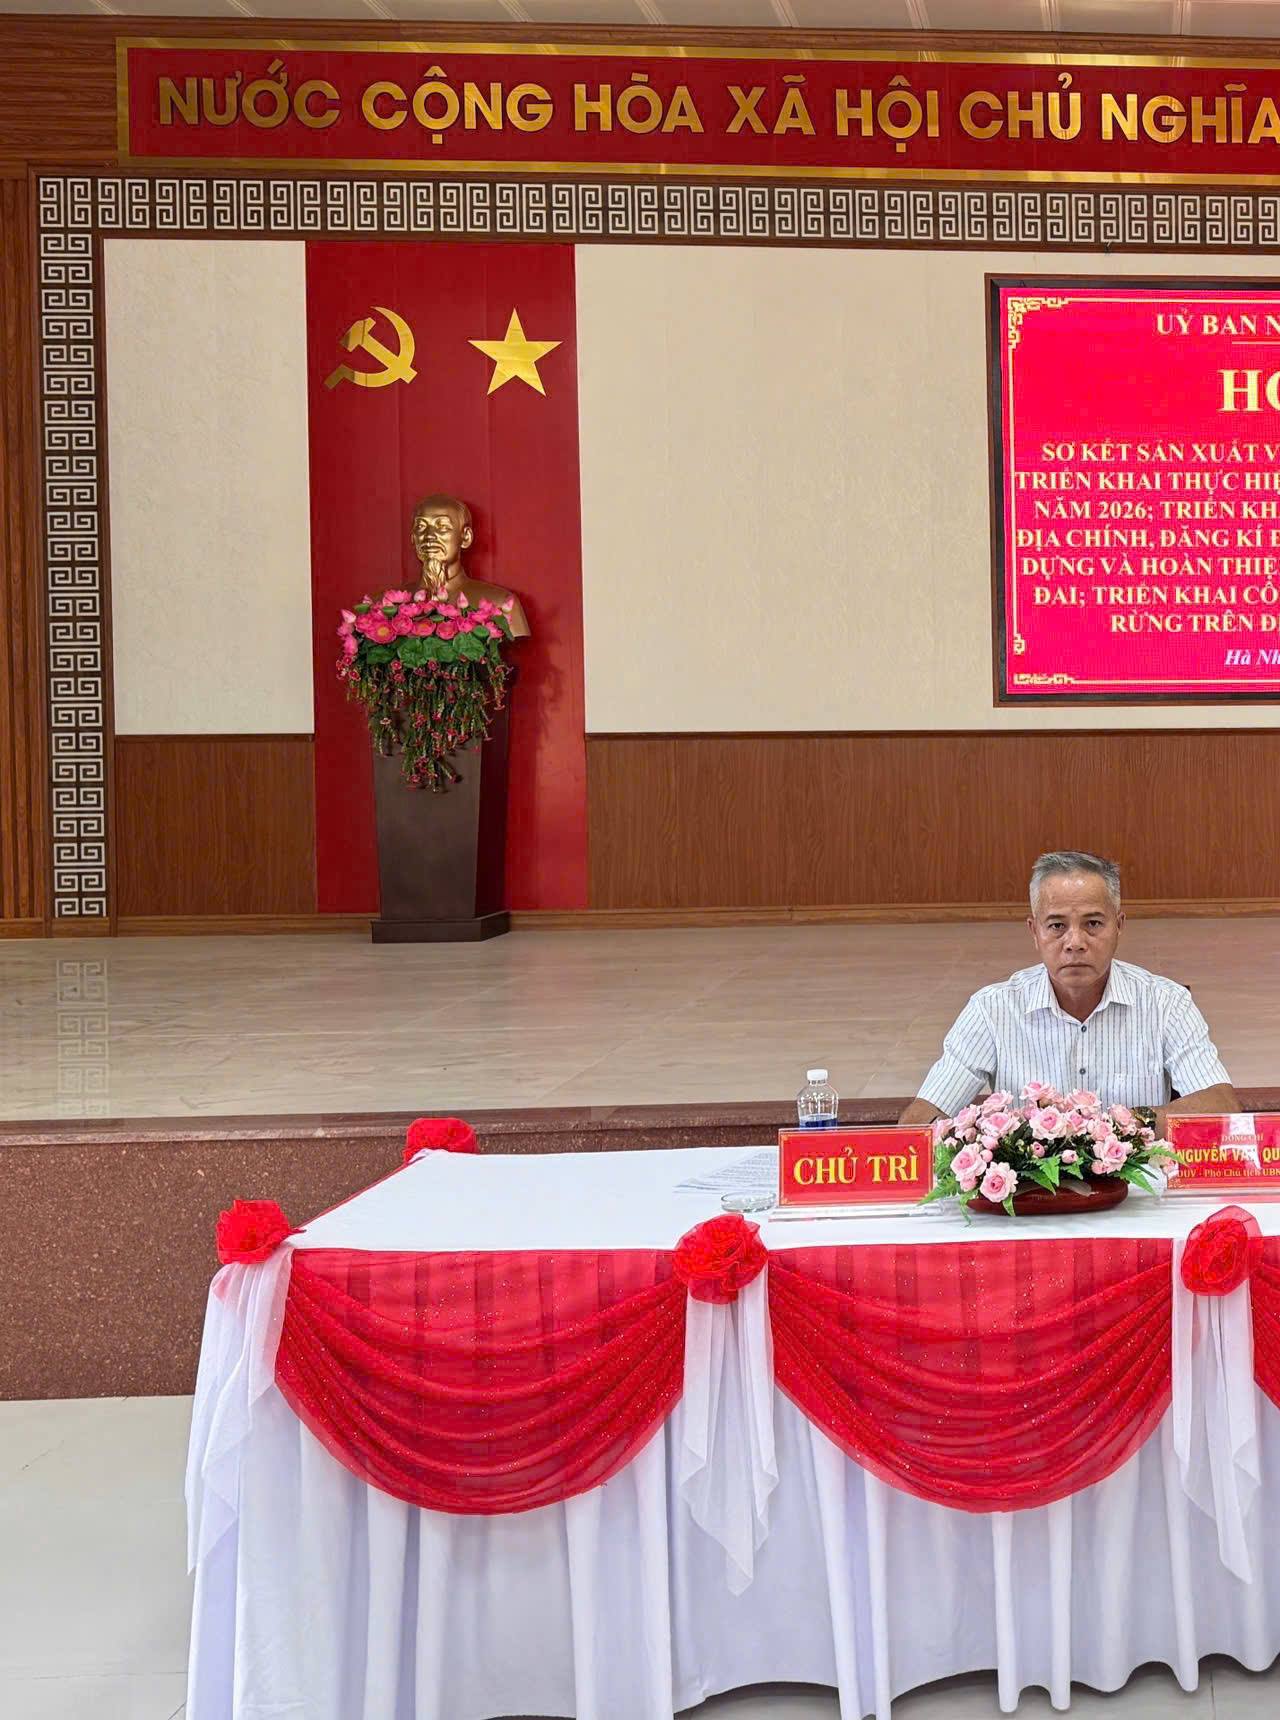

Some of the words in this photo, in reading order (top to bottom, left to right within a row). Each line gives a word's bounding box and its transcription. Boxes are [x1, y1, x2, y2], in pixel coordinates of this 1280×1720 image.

[158, 58, 341, 129] NƯỚC
[361, 65, 553, 145] CỘNG
[726, 73, 816, 136] XÃ
[835, 74, 939, 153] HỘI
[958, 71, 1083, 141] CHỦ
[1157, 307, 1192, 336] UỶ
[1203, 315, 1257, 336] BAN
[1041, 442, 1076, 461] SƠ
[1080, 438, 1132, 461] KẾT
[1135, 439, 1185, 461] SẢN
[1190, 438, 1260, 461] XUẤT
[1014, 466, 1092, 489] TRIỂN
[1098, 472, 1162, 489] KHAI
[1167, 470, 1240, 494] THỰC
[1033, 496, 1092, 518] NĂM
[1098, 501, 1154, 521] 2026;
[1158, 495, 1236, 518] TRIỂN
[1016, 530, 1062, 552] ĐỊA
[1065, 525, 1156, 550] CHÍNH,
[1159, 524, 1230, 546] ĐĂNG
[1236, 524, 1263, 546] KÍ
[1021, 556, 1096, 580] DỰNG
[1099, 553, 1135, 575] VÀ
[1141, 552, 1213, 575] HOÀN
[1033, 587, 1086, 607] ĐAI;
[1091, 581, 1169, 603] TRIỂN
[1174, 586, 1238, 603] KHAI
[1110, 610, 1183, 632] RỪNG
[1187, 609, 1254, 631] TRÊN
[1224, 649, 1250, 666] Hà
[793, 1146, 859, 1186] CHỦ
[867, 1145, 918, 1183] TRÌ
